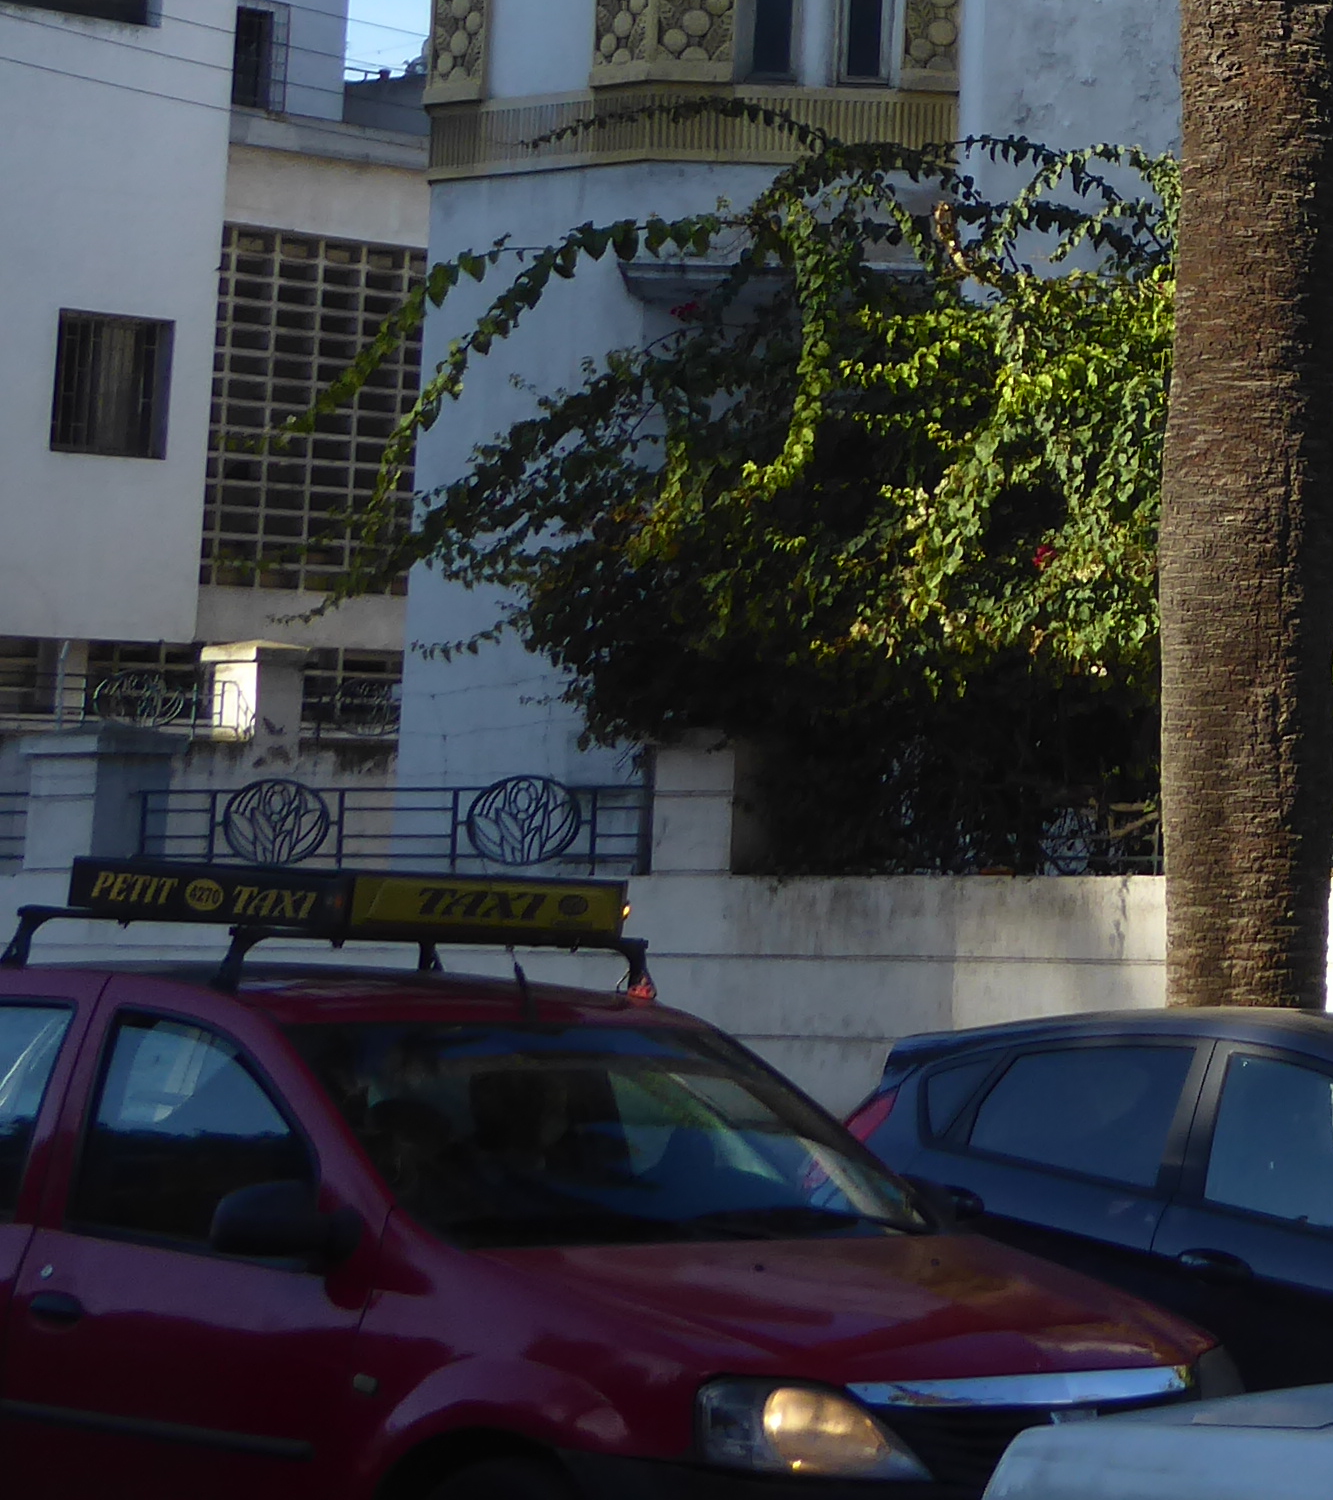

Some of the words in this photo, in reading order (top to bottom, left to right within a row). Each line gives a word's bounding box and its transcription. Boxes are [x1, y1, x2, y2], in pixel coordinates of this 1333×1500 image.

[91, 871, 179, 905] PETIT
[232, 885, 318, 919] TAXI
[418, 887, 547, 920] TAXI
